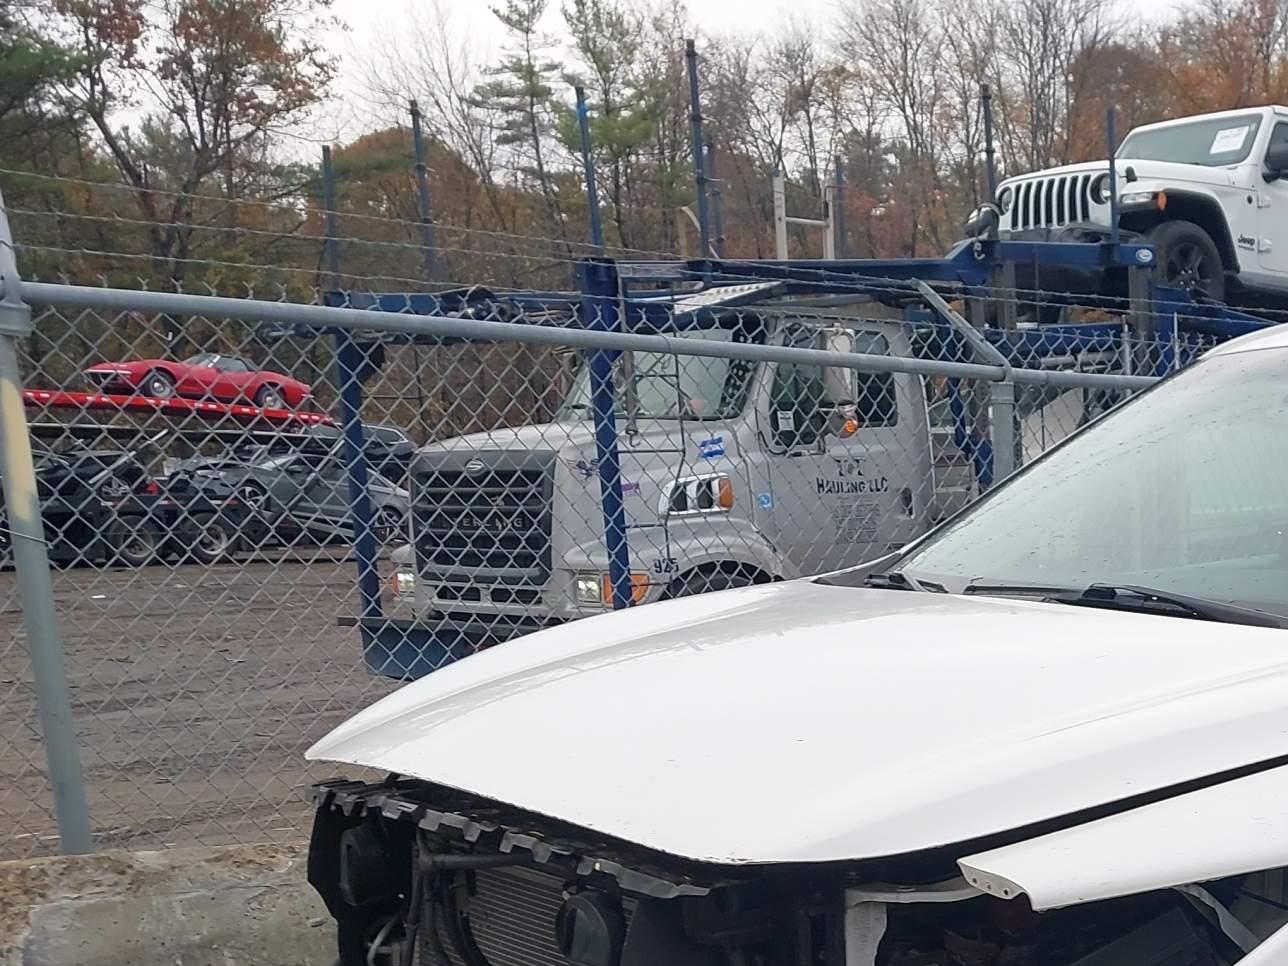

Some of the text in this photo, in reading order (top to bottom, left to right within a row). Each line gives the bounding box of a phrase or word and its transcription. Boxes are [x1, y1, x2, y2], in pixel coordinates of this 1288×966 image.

[816, 476, 889, 494] HAULING LLC
[654, 558, 680, 573] 925
